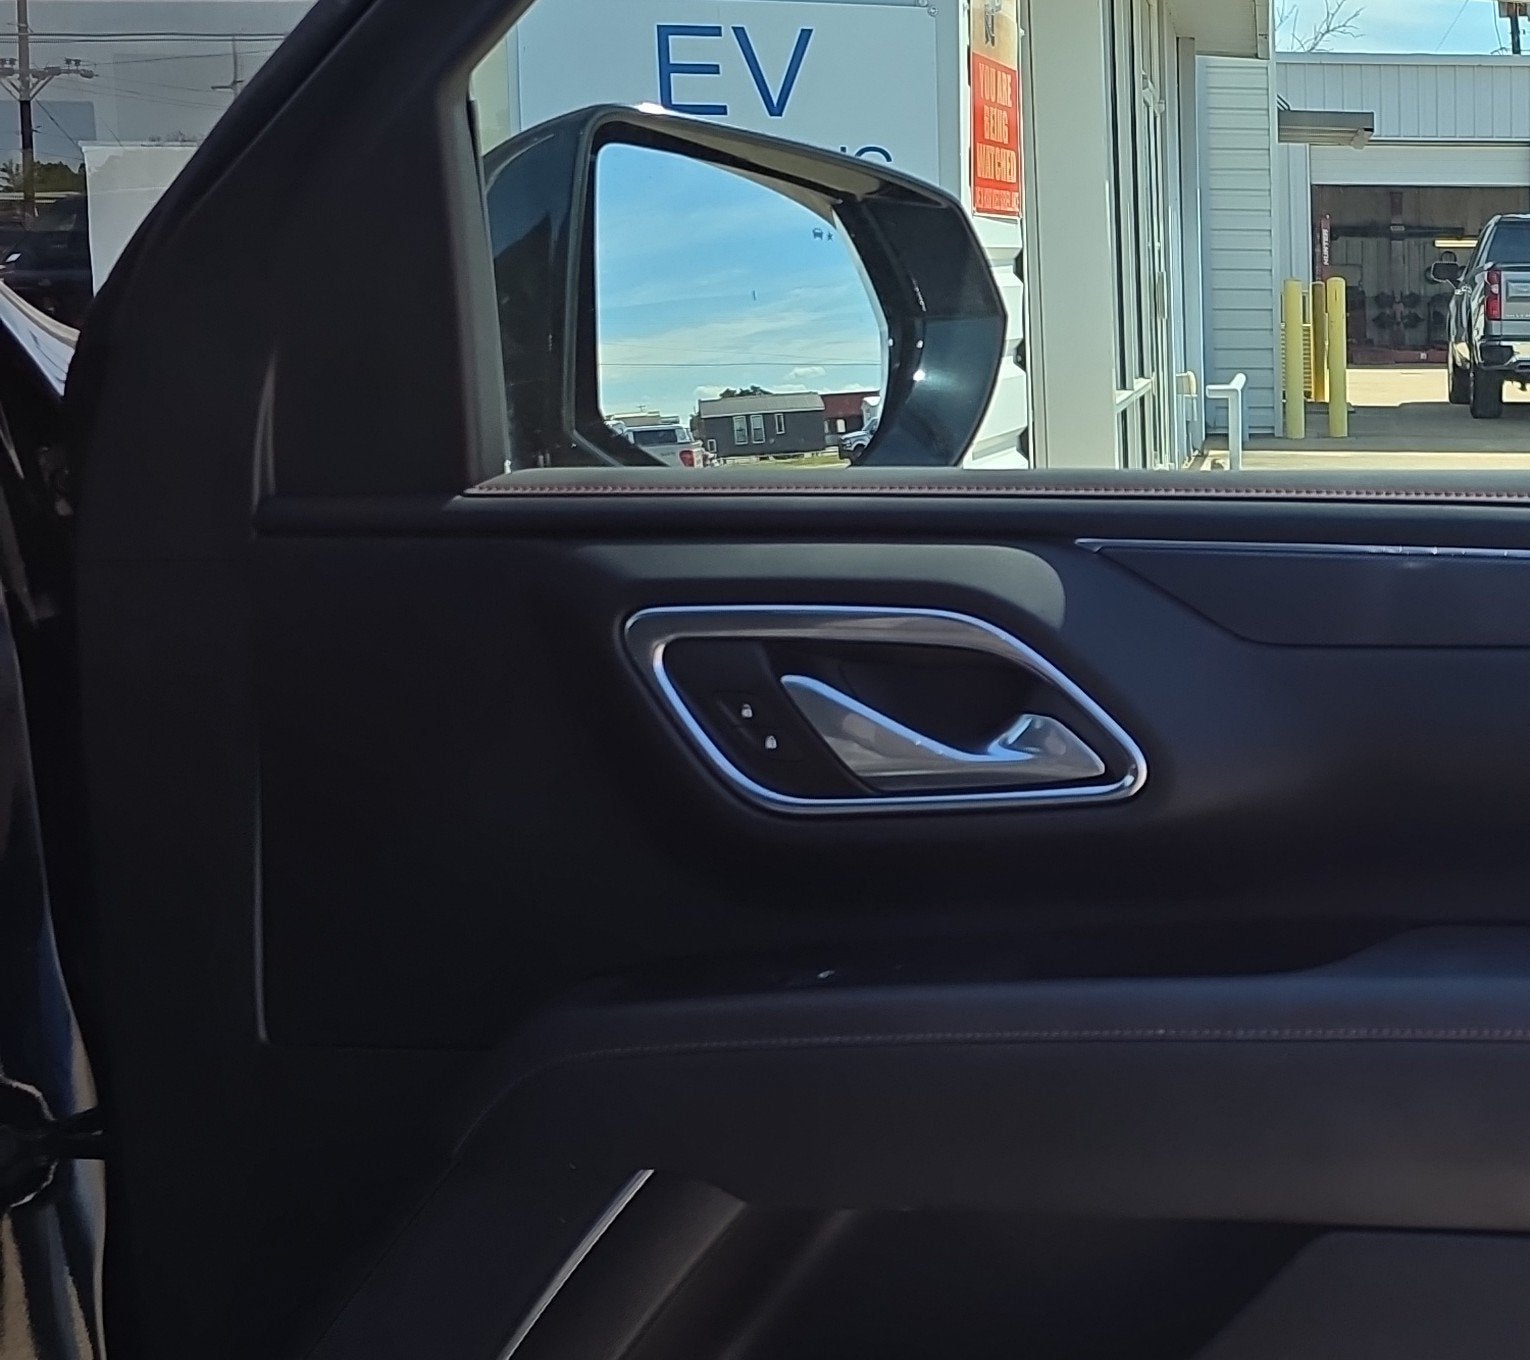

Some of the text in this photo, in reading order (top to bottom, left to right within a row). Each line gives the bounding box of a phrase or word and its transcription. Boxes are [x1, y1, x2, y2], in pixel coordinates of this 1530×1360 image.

[656, 24, 813, 117] EV
[979, 62, 1012, 108] YOU ARE
[984, 104, 1009, 144] BEING
[977, 142, 1017, 184] WATCHED
